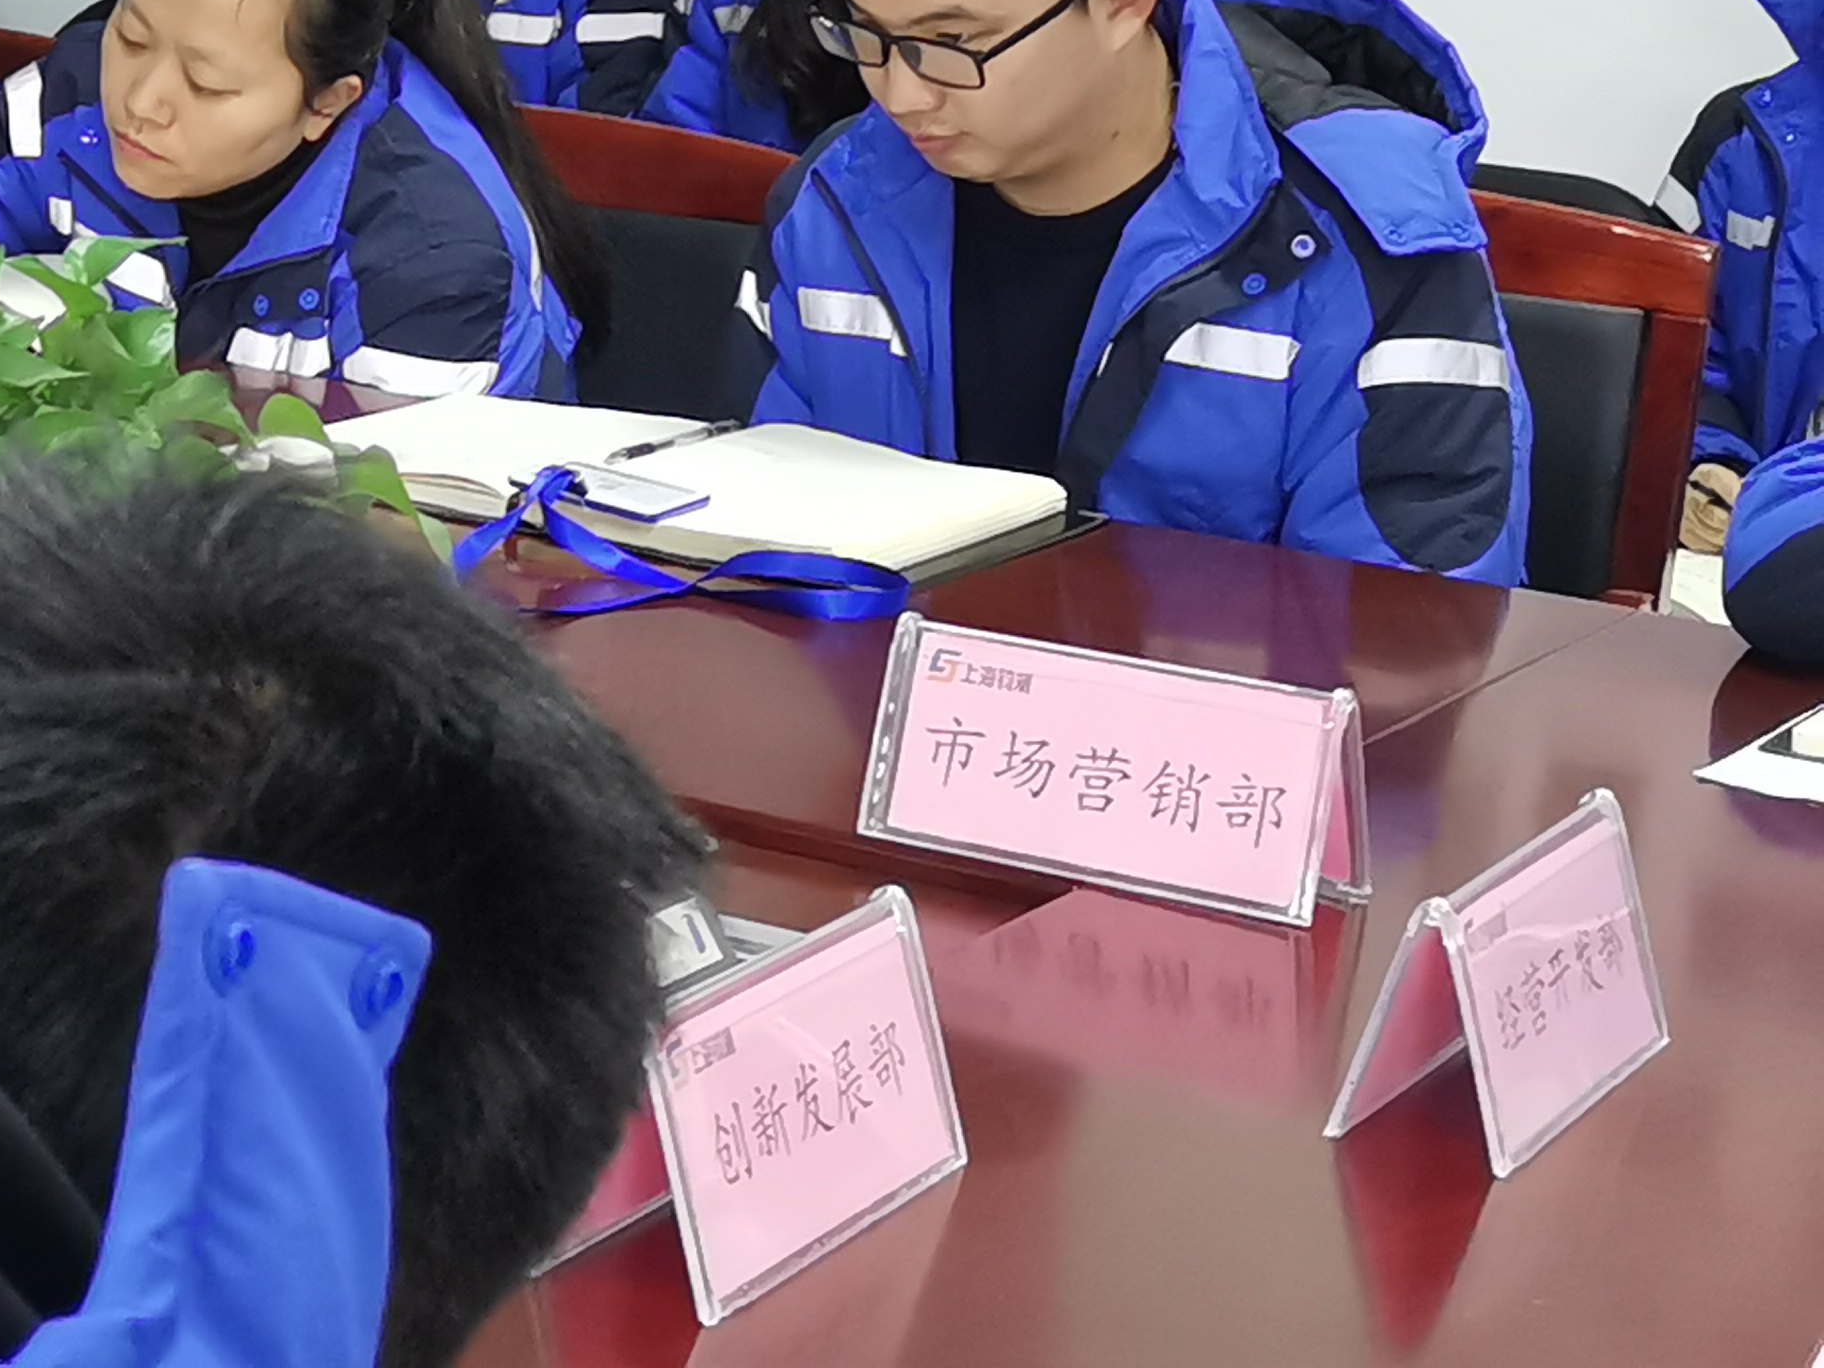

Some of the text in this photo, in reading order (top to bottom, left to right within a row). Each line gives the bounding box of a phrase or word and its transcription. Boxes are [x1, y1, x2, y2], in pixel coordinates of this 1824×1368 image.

[925, 716, 1286, 848] 市场营销部
[713, 1021, 906, 1185] 创新发展部
